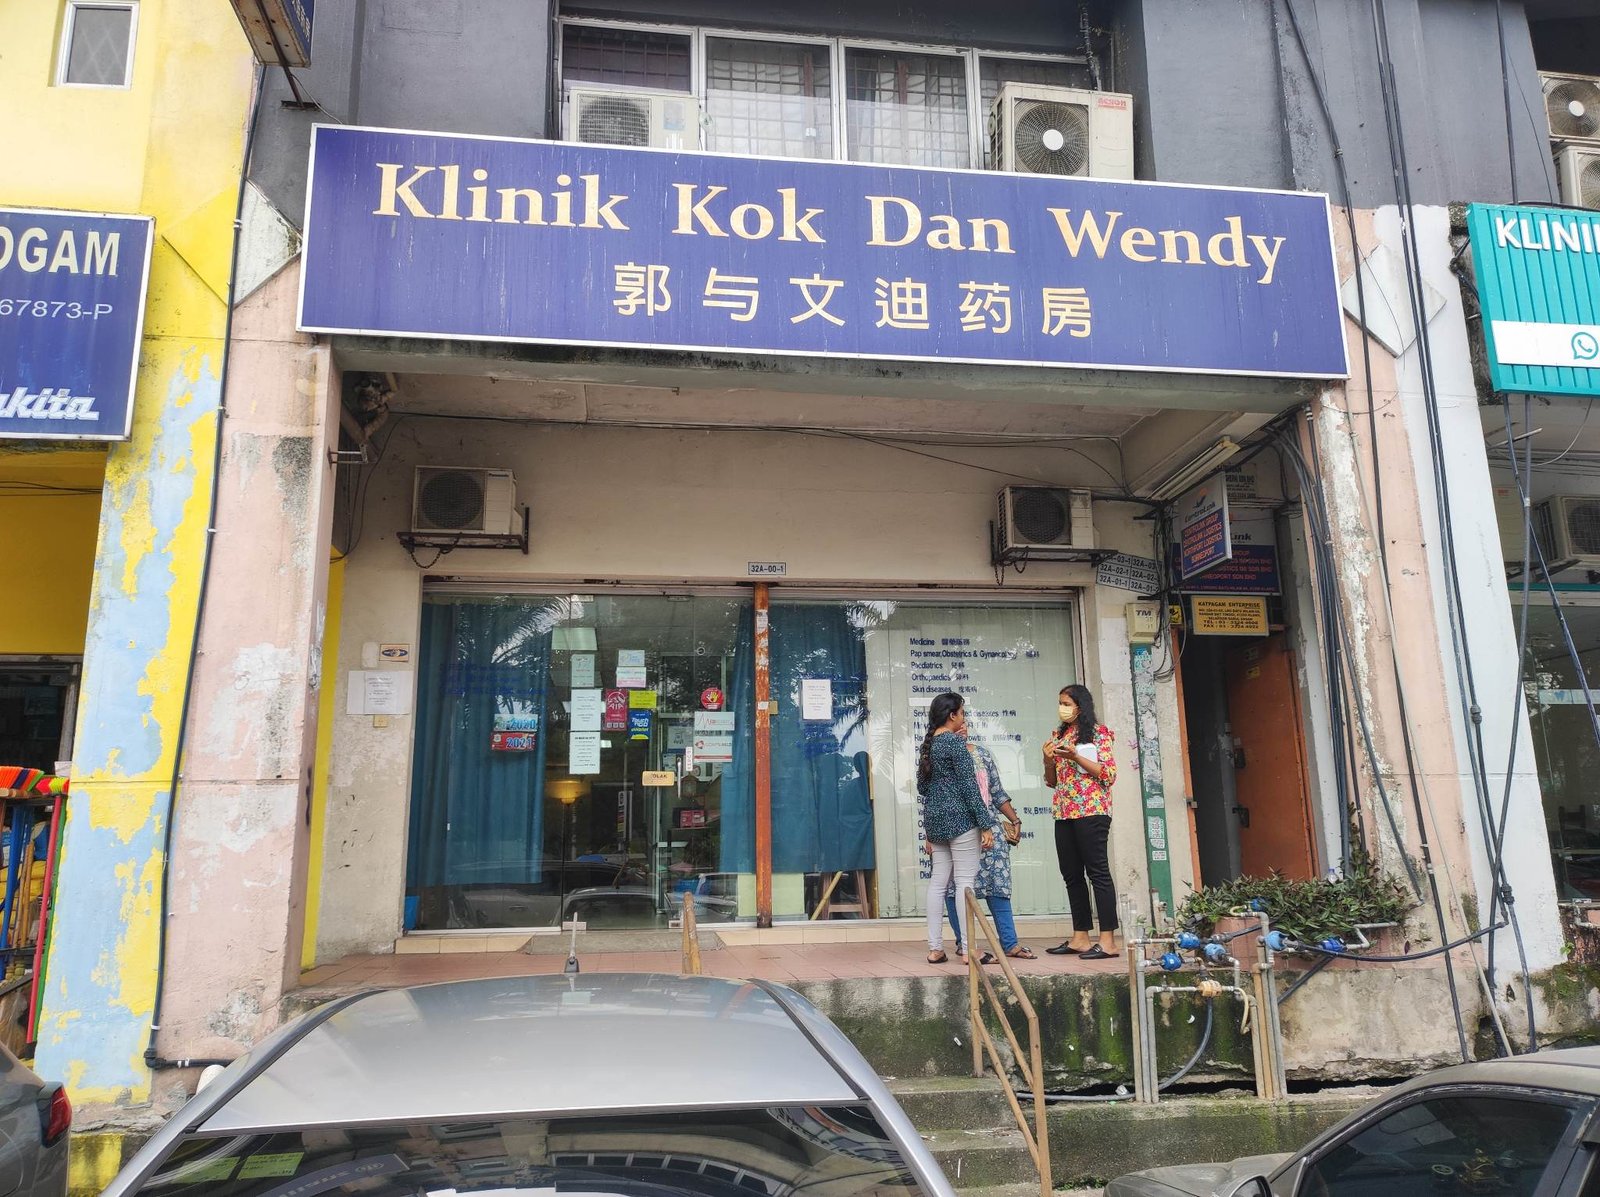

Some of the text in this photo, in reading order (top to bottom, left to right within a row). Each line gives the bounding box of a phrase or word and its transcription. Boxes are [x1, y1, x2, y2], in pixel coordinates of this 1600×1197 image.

[372, 163, 1286, 285] Klinik Kok Dan Wendy
[1495, 216, 1600, 254] KLINI
[613, 262, 1092, 338] 郭与文迪药房
[751, 565, 784, 573] 32A-00-1
[1133, 558, 1156, 570] 32A-03
[1101, 564, 1158, 581] 32A-02-1 32A-02-
[1100, 574, 1128, 587] 32A-01-1
[910, 638, 935, 646] Medicine
[910, 650, 922, 659] Pap
[506, 737, 532, 748] 2021
